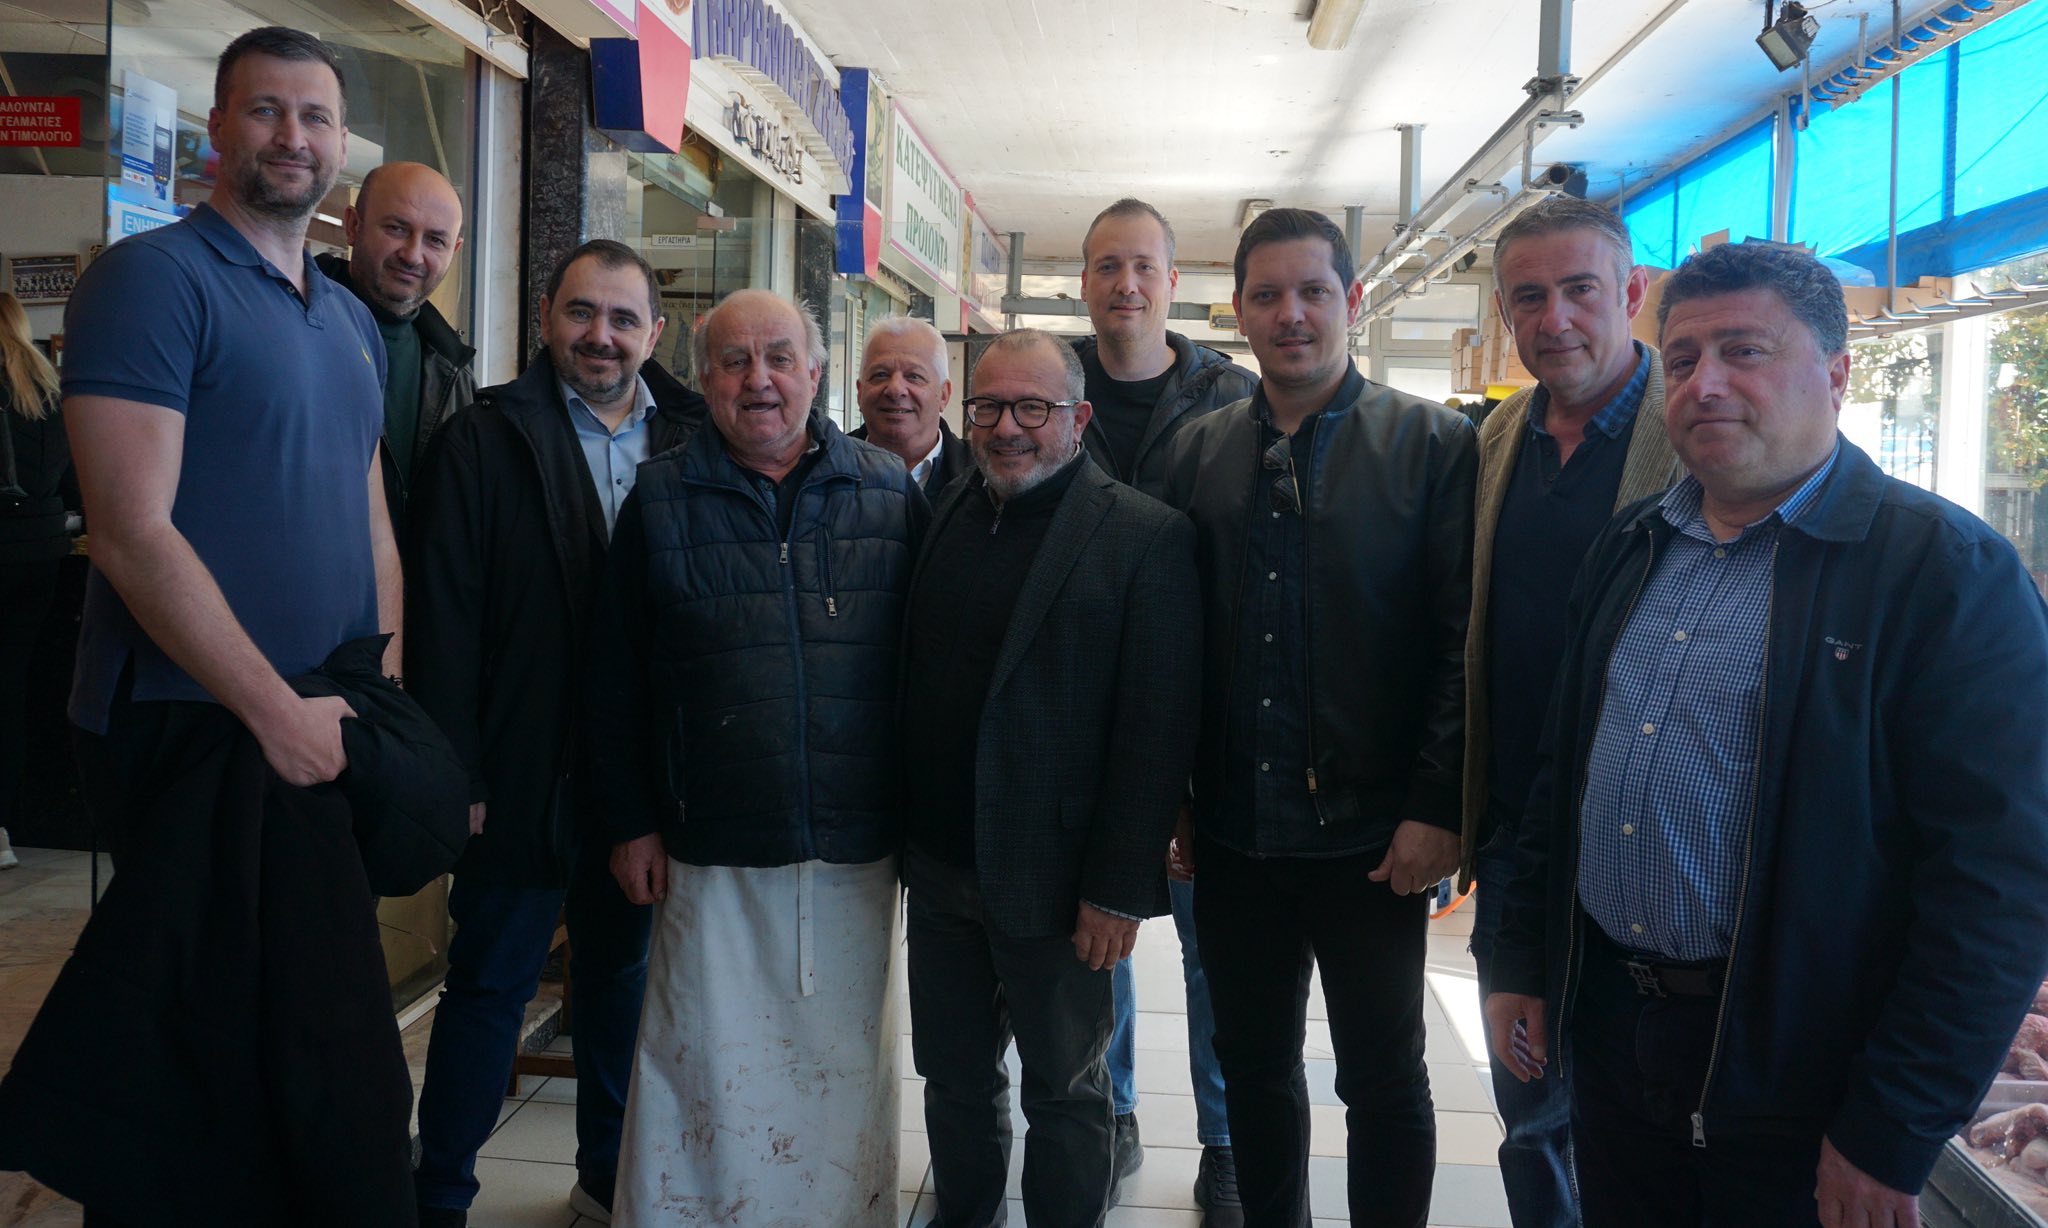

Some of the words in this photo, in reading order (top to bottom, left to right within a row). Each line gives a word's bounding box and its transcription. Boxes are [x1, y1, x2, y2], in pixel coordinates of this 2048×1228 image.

[11, 131, 73, 141] ΤΙΜΟΛΟΓΙΟ
[896, 123, 957, 228] ΚΑΤΕΨΥΓΜΕΝΑ
[658, 236, 691, 244] ΕΡΓΑΣΤΗΡΙΑ
[906, 202, 948, 274] ΠΡΟΙΟΝΤΑ
[1824, 636, 1863, 650] GANT
